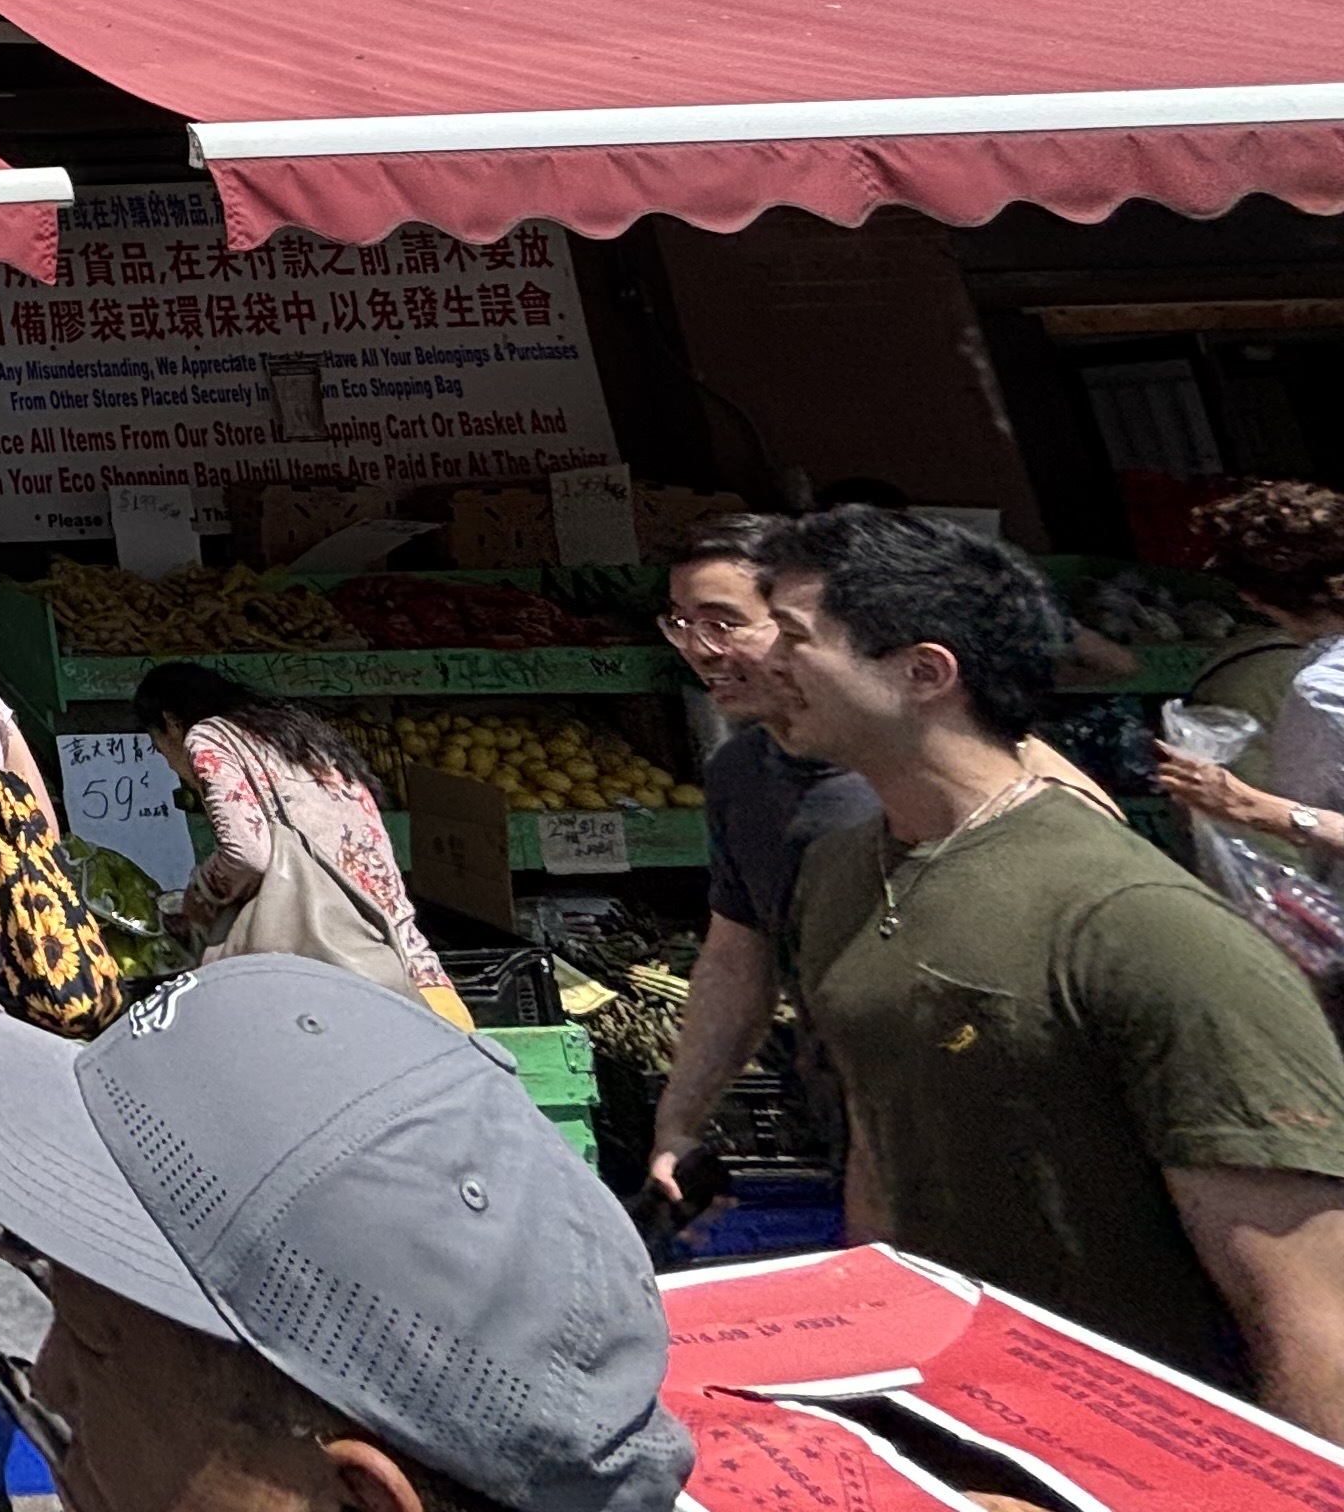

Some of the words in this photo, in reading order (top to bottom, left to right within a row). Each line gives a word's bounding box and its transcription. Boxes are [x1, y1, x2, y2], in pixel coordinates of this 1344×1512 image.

[26, 357, 154, 381] Misunderstanding,
[156, 356, 178, 375] We
[182, 354, 257, 378] Appreciate
[323, 347, 358, 369] Have
[361, 347, 380, 368] All
[381, 345, 412, 367] Your
[415, 345, 490, 368] Belongings
[494, 345, 505, 362] &
[507, 341, 580, 362] Purchases
[10, 391, 47, 412] From
[50, 389, 89, 409] Other
[93, 387, 139, 408] Stores
[142, 385, 188, 407] Placed
[190, 383, 254, 407] Securely
[256, 383, 270, 402] In
[341, 378, 367, 399] Eco
[370, 376, 433, 401] Shopping
[434, 375, 463, 399] Bag
[30, 428, 56, 453] All
[61, 426, 116, 452] Items
[119, 424, 171, 450] From
[174, 422, 208, 448] Our
[213, 419, 266, 446] Store
[324, 416, 383, 448] opping
[386, 414, 426, 440] Cart
[431, 412, 455, 437] Or
[457, 410, 524, 437] Basket
[531, 408, 568, 434] And
[8, 467, 53, 495] Your
[58, 467, 96, 493] Eco
[193, 461, 231, 487] Bag
[235, 458, 283, 486] Until
[286, 456, 342, 481] Items
[348, 455, 381, 481] Are
[384, 453, 428, 481] Paid
[430, 452, 463, 478] For
[467, 450, 492, 477] At
[493, 449, 532, 475] The
[534, 447, 608, 474] Cashier
[47, 512, 104, 528] Please
